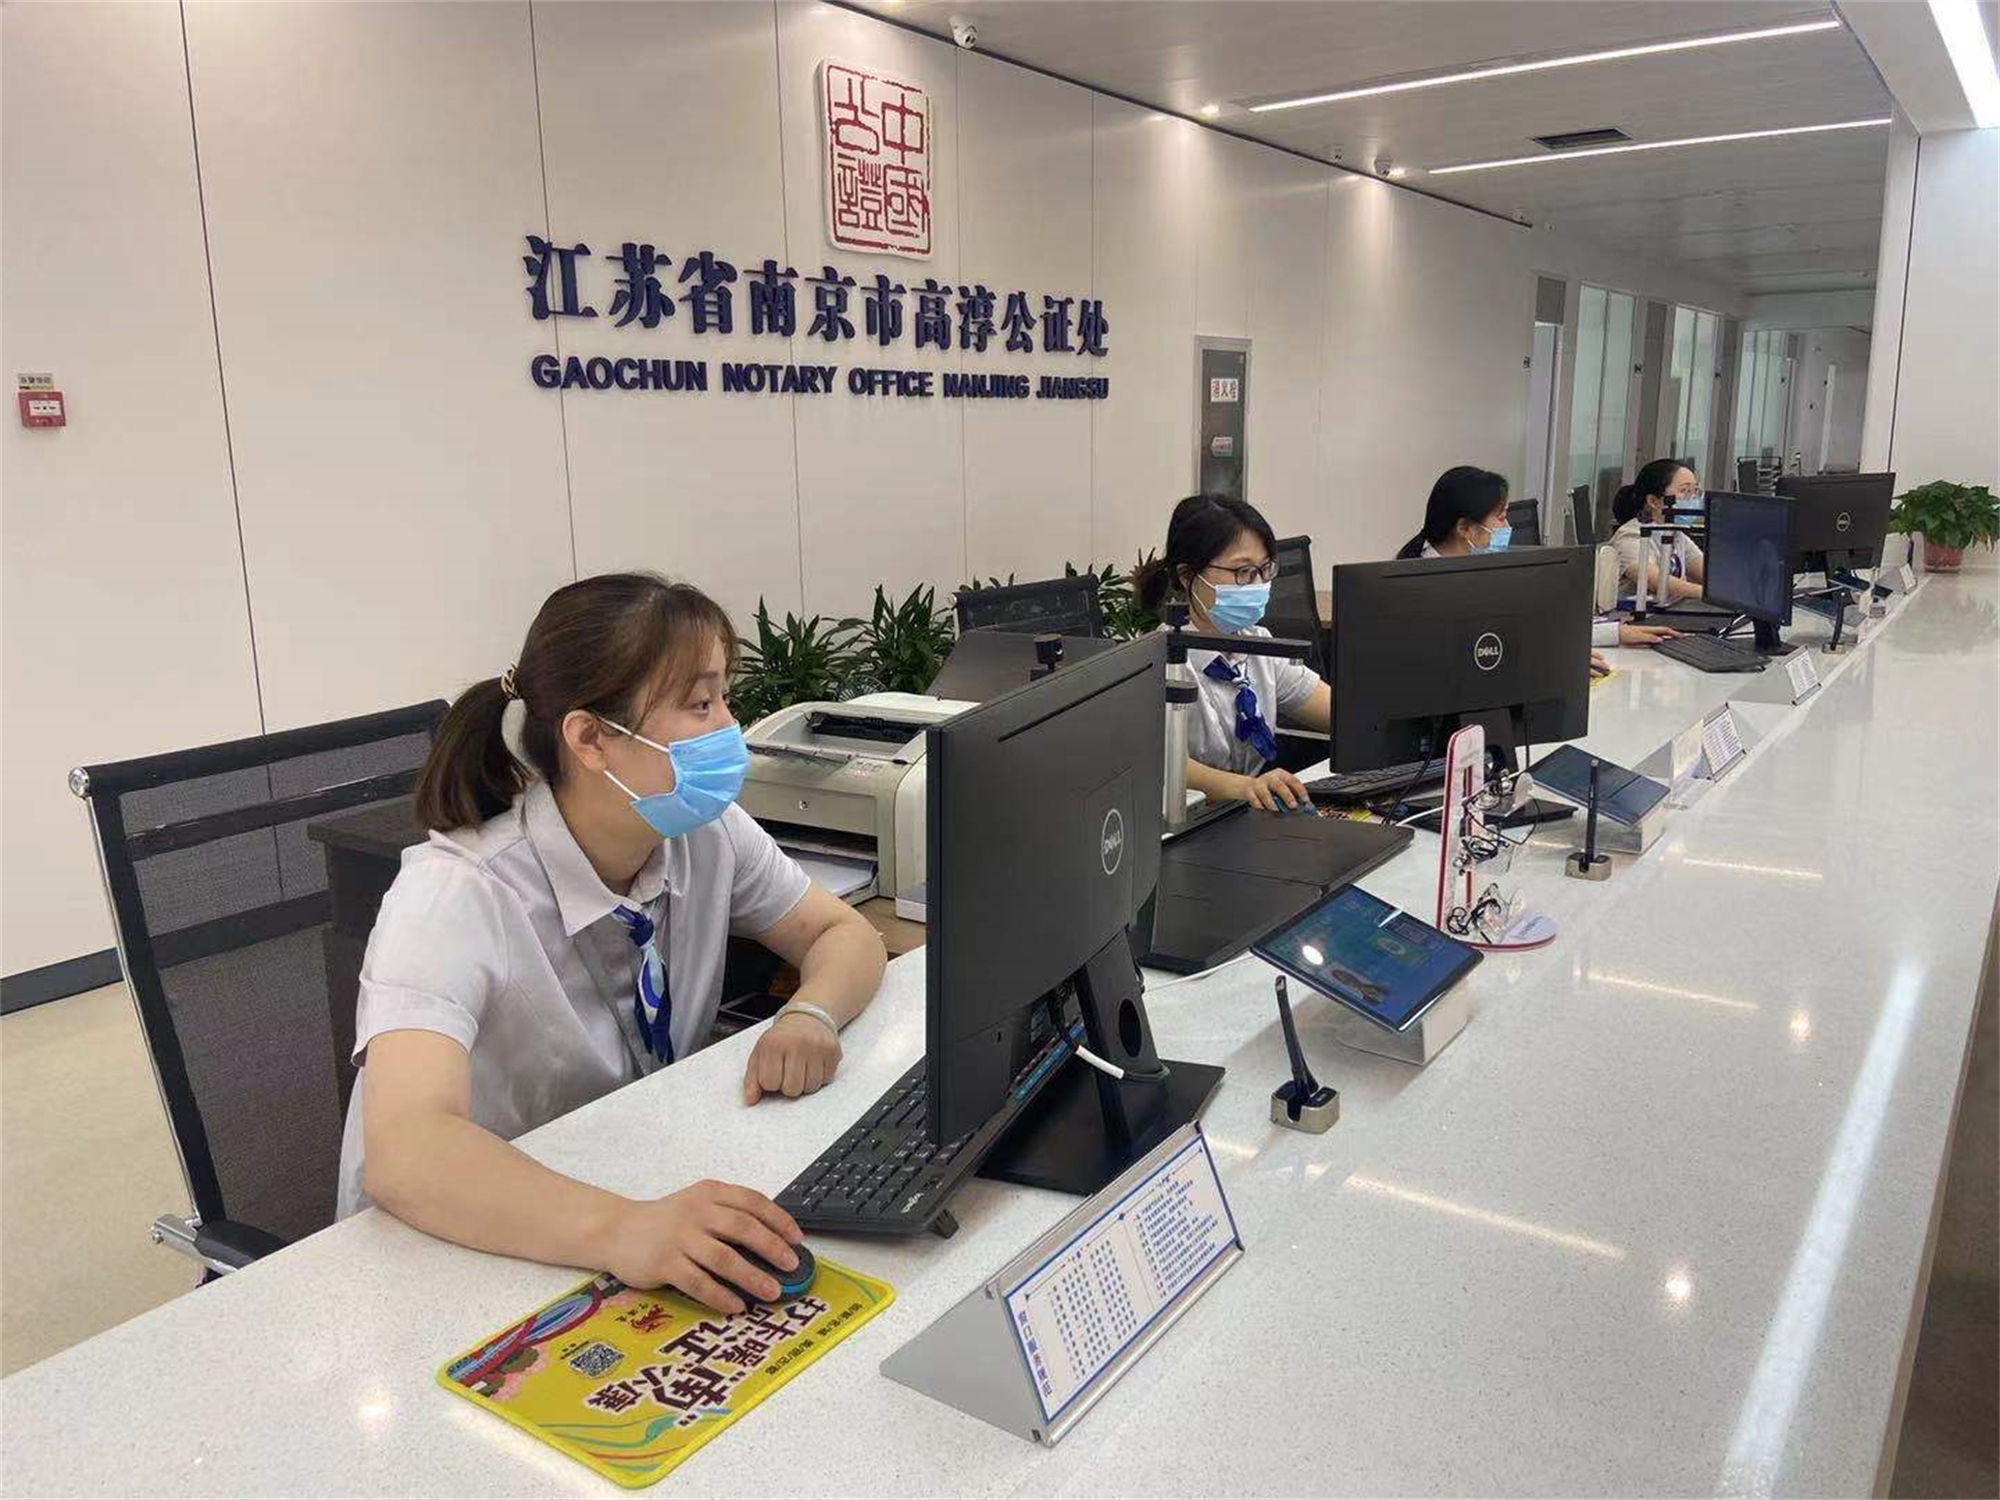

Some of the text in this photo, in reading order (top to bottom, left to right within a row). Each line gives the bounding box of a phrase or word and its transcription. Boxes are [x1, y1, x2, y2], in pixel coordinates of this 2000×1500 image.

[522, 235, 1109, 357] 江苏省南京市高淳公证处
[531, 354, 1109, 400] GAOCHUN NOTARY OFFICE NANJING JIANGSU
